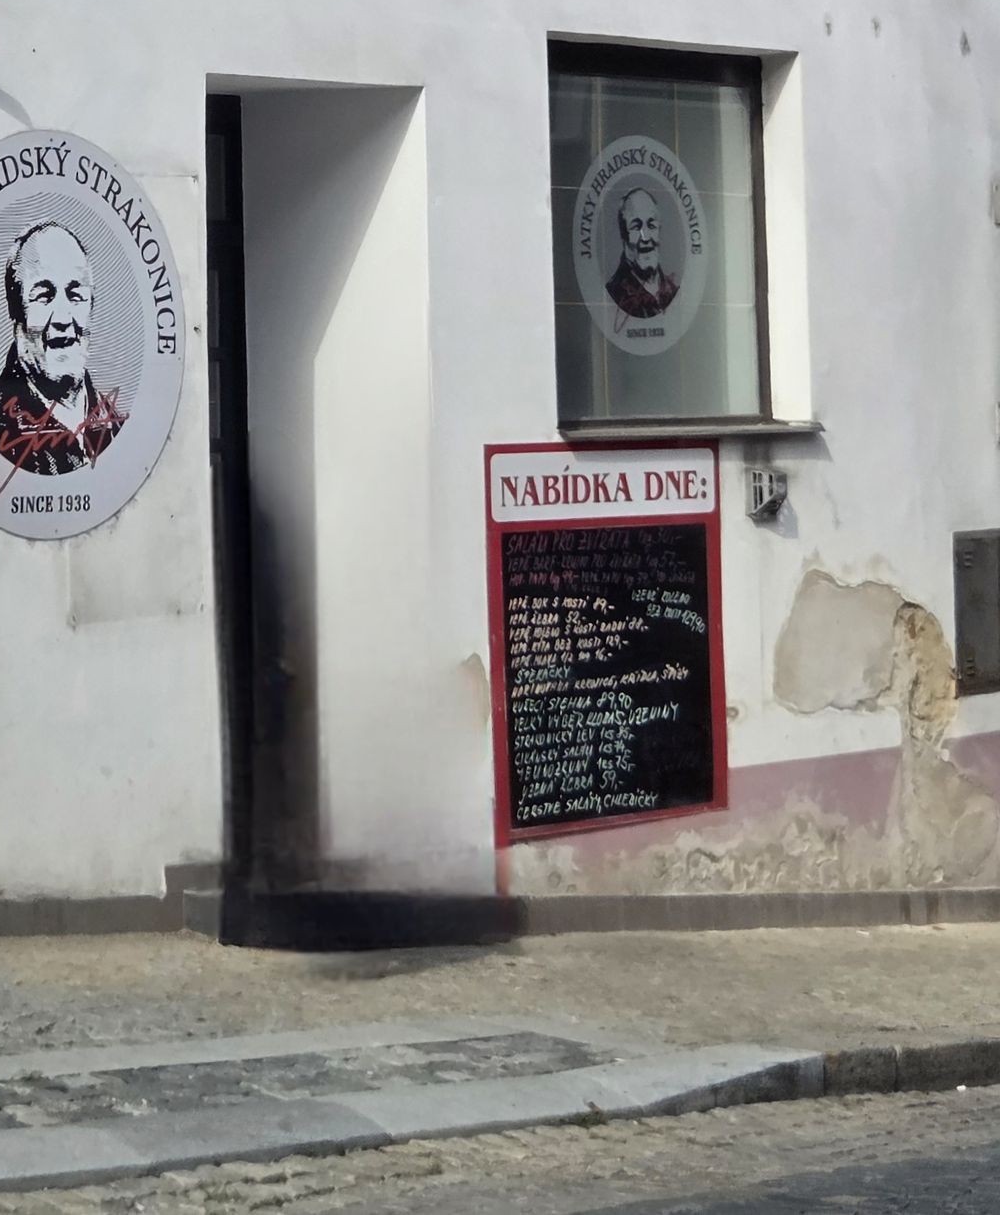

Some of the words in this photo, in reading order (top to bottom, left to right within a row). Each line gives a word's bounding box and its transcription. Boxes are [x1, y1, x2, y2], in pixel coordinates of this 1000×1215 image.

[580, 194, 596, 259] JATKY
[591, 145, 647, 197] HRADSKÝ
[649, 152, 702, 255] STRAKONICE
[75, 155, 177, 355] STRAKONICE
[500, 464, 633, 507] NABÍDKA
[644, 470, 707, 501] DNE:
[11, 495, 53, 514] SINCE
[58, 494, 91, 512] 1938
[531, 597, 549, 610] BOK
[551, 596, 559, 608] S
[564, 624, 571, 635] S
[554, 637, 572, 652] BEZ
[547, 695, 592, 711] STEHNA
[596, 691, 632, 710] 89,90
[576, 727, 596, 743] LEV
